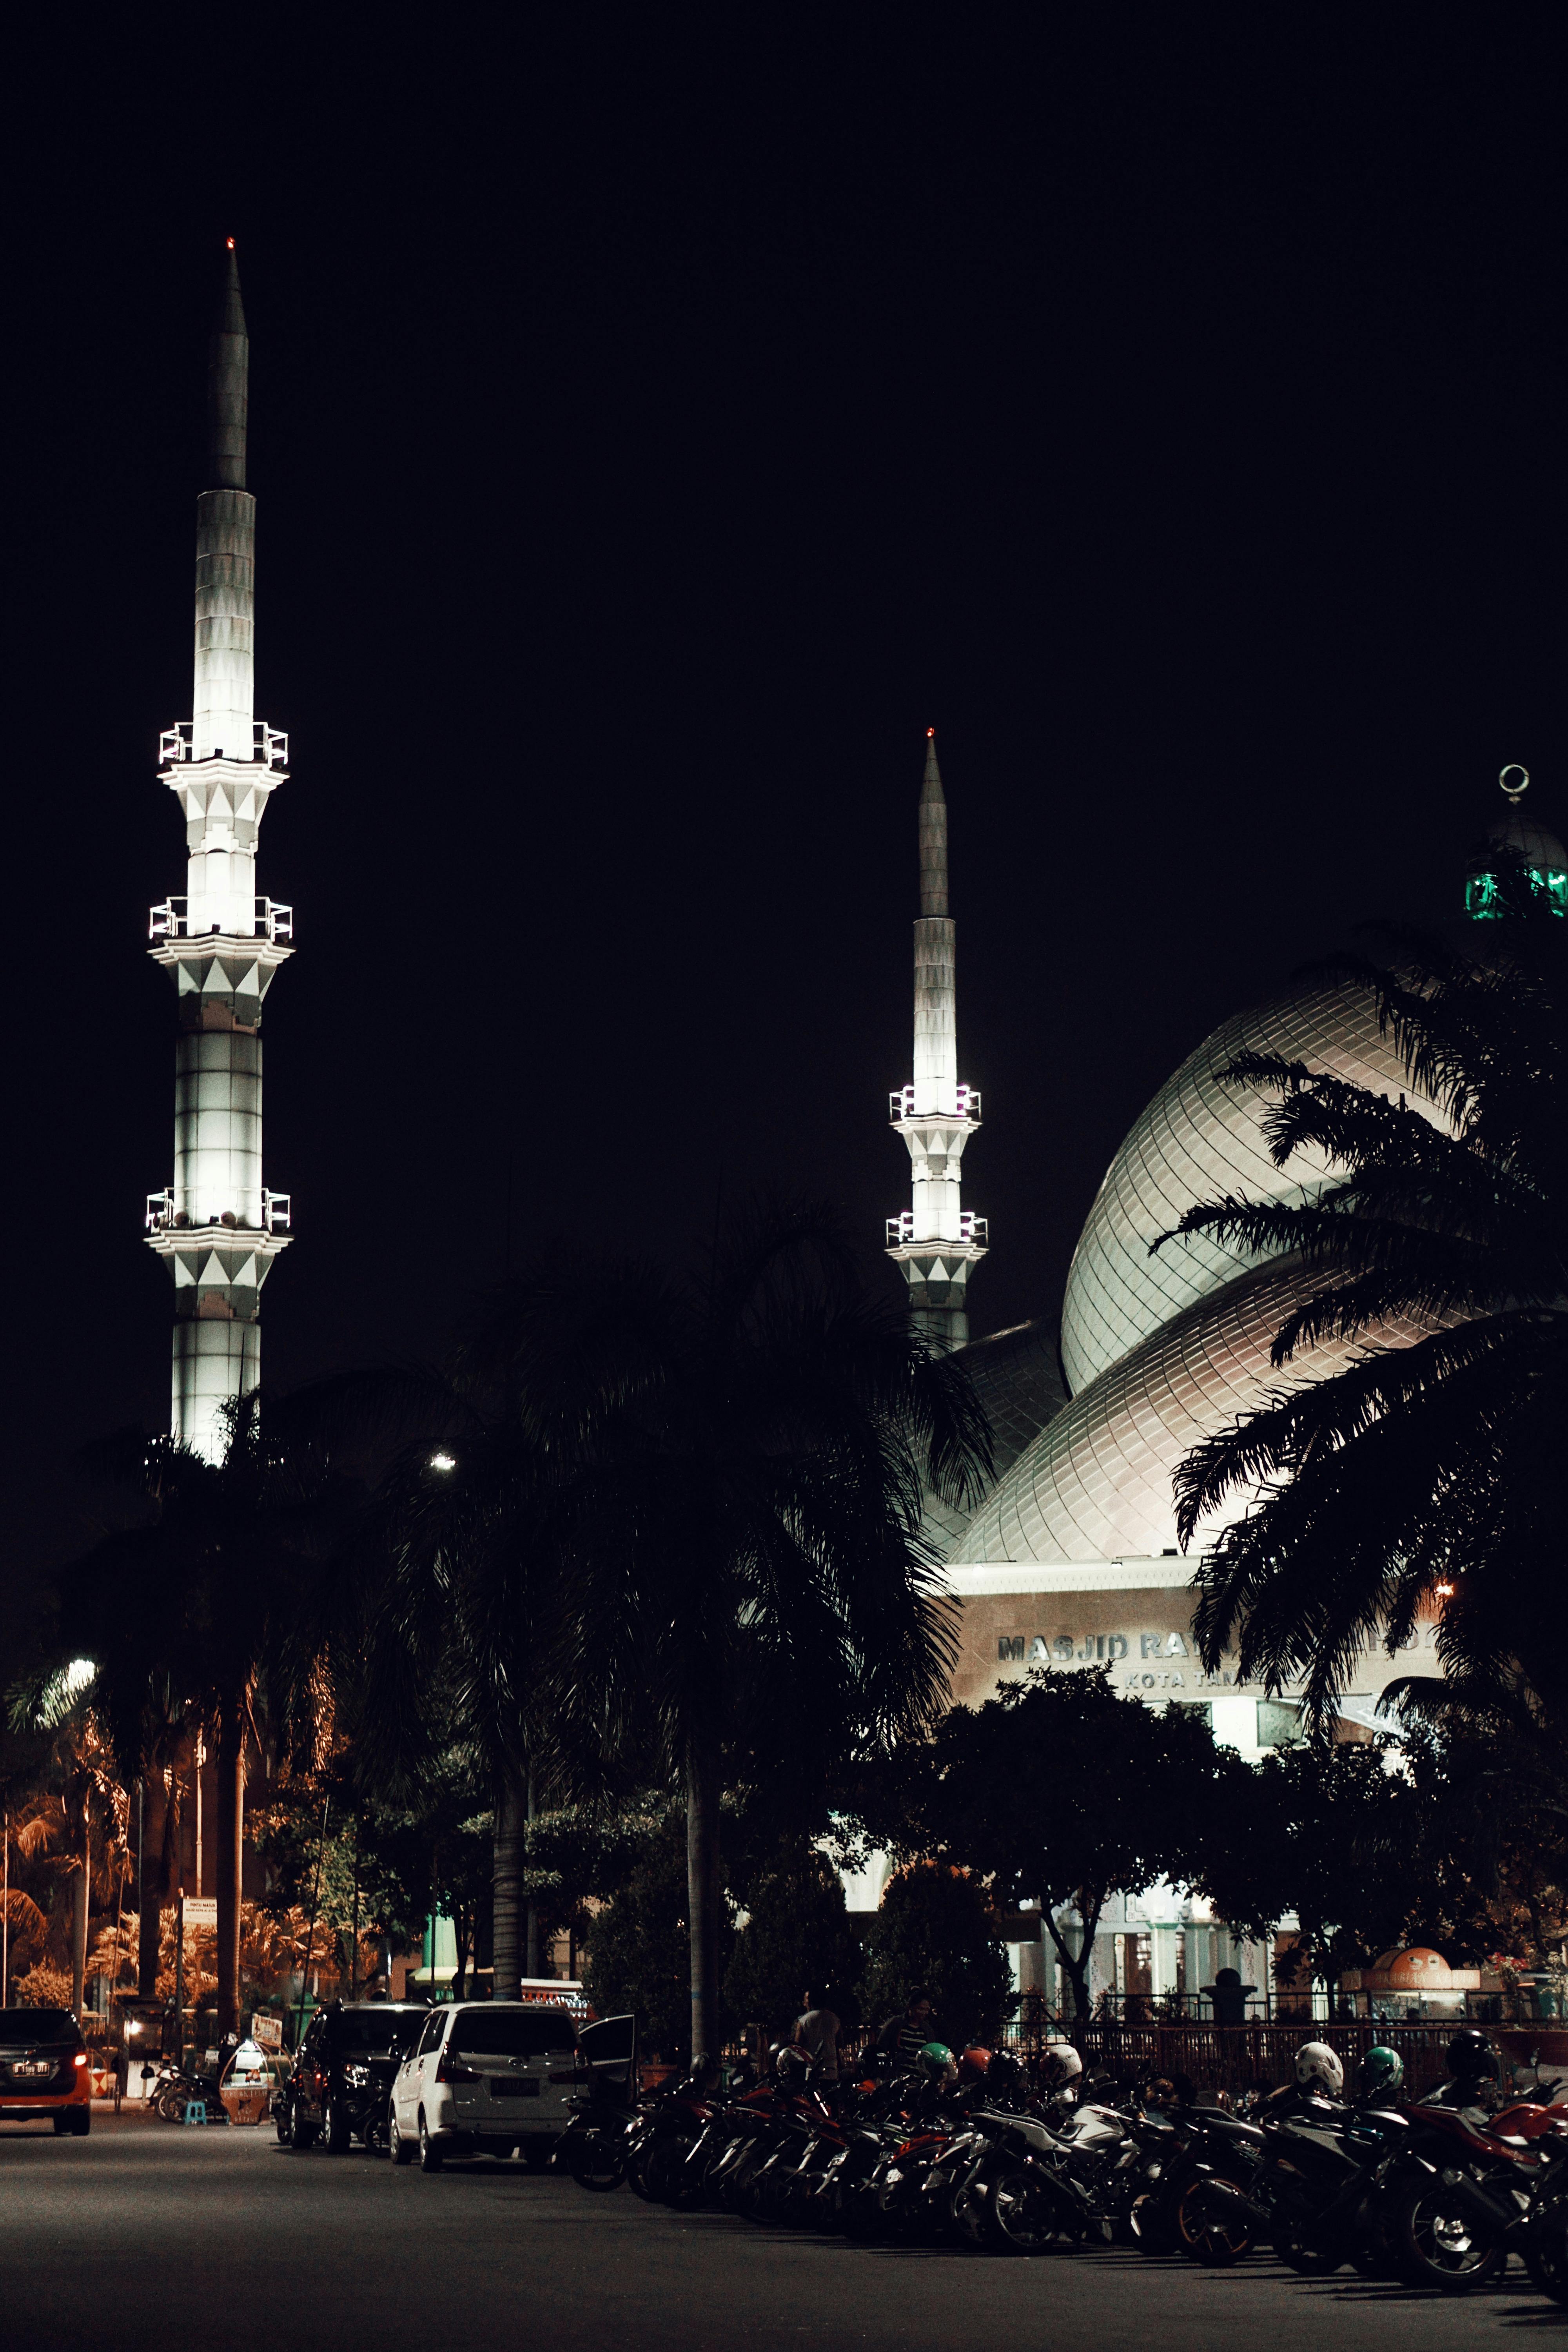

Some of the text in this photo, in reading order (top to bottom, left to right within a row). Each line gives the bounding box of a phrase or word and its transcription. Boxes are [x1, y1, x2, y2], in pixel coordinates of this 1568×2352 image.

[998, 1635, 1128, 1662] MASJID
[1125, 1671, 1185, 1689] KOTA
[1436, 1972, 1475, 1983] KEBAB
